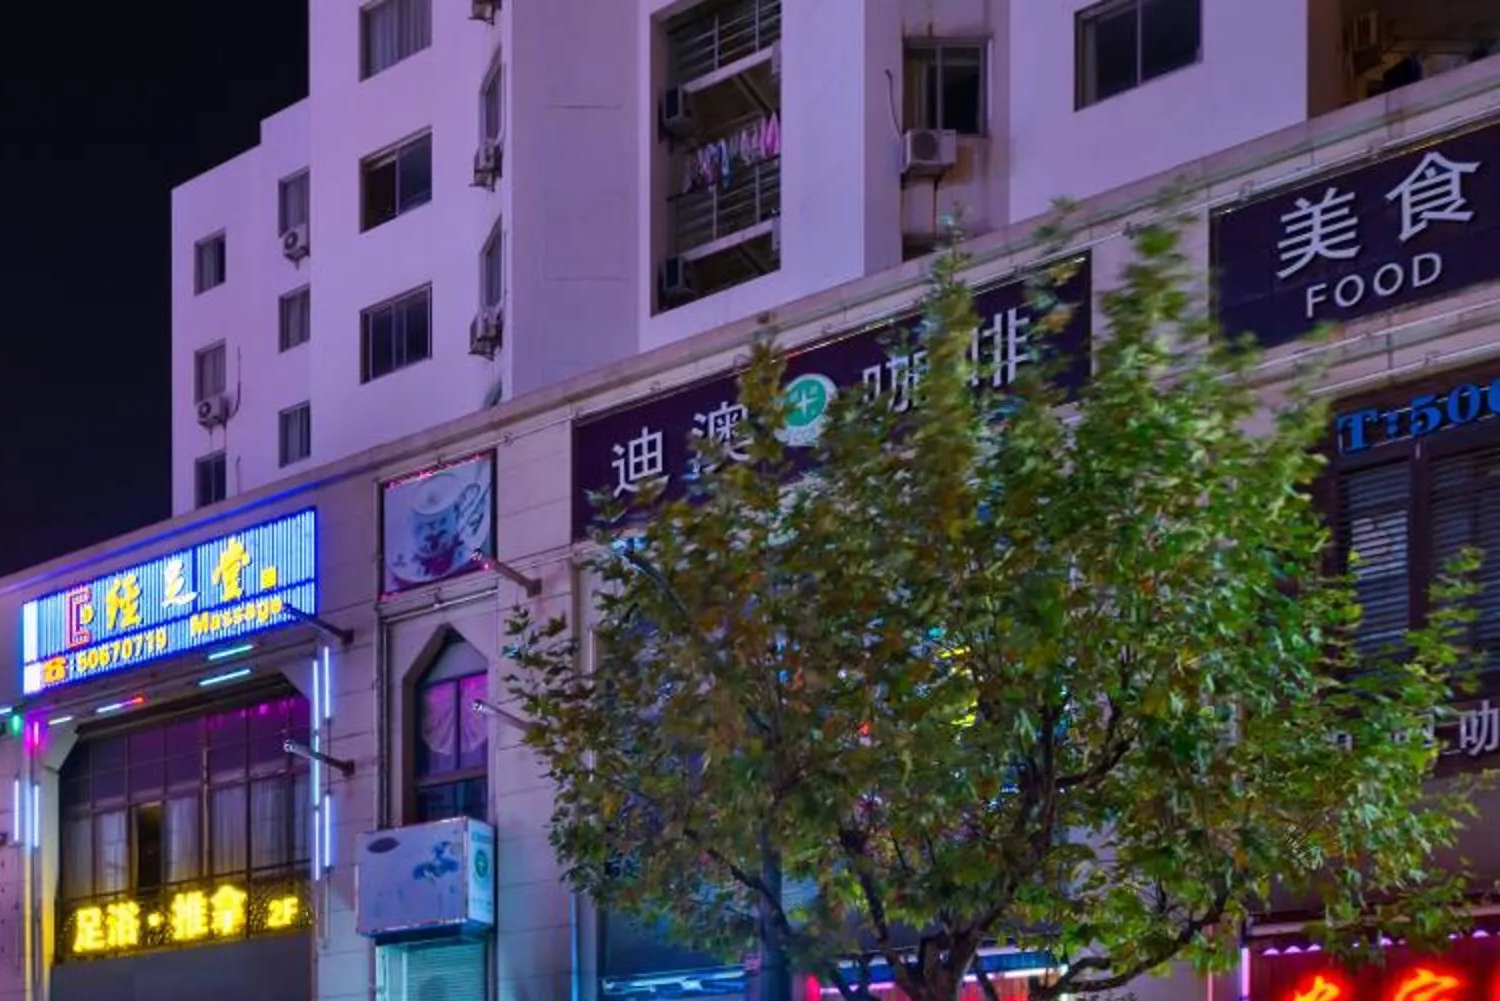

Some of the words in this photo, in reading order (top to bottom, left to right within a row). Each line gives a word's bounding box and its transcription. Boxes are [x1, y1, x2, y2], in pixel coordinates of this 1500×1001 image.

[1276, 151, 1482, 279] 美食
[1306, 253, 1442, 318] FOOD
[612, 402, 752, 497] 迪澳
[190, 598, 283, 637] Massage
[268, 897, 298, 928] 2F
